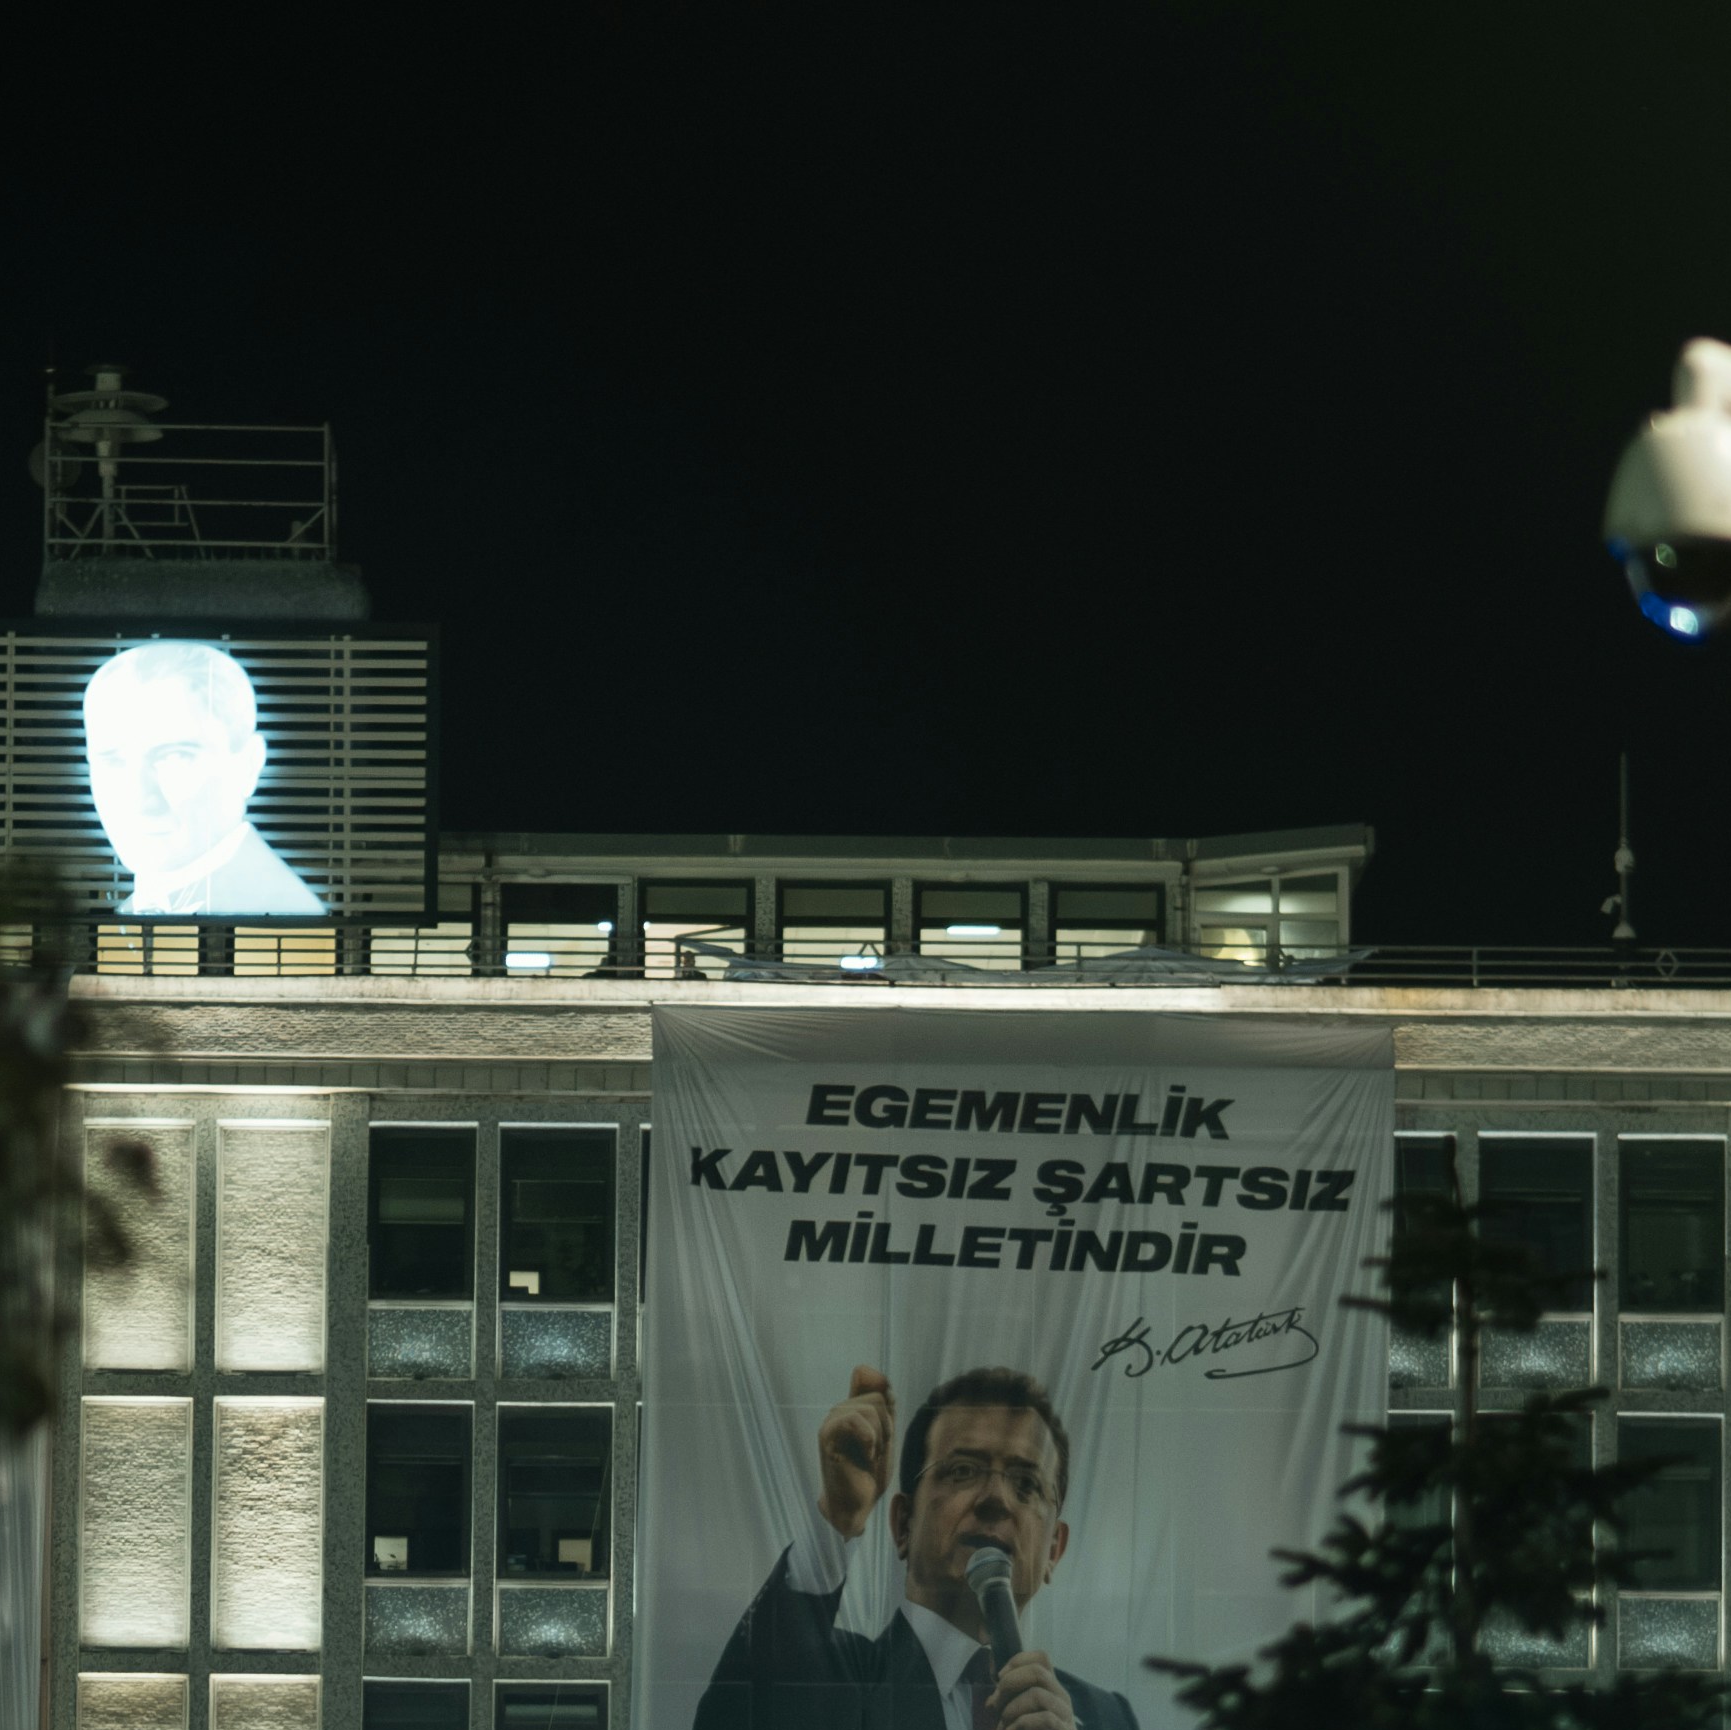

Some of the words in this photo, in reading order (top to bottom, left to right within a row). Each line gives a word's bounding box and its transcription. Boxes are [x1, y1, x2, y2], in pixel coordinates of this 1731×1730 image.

[805, 1084, 1235, 1140] EGEMENLİK
[690, 1147, 1017, 1201] KAYITSIZ
[1032, 1159, 1356, 1217] ŞARTSIZ
[784, 1211, 1248, 1277] MİLLETİNDİR
